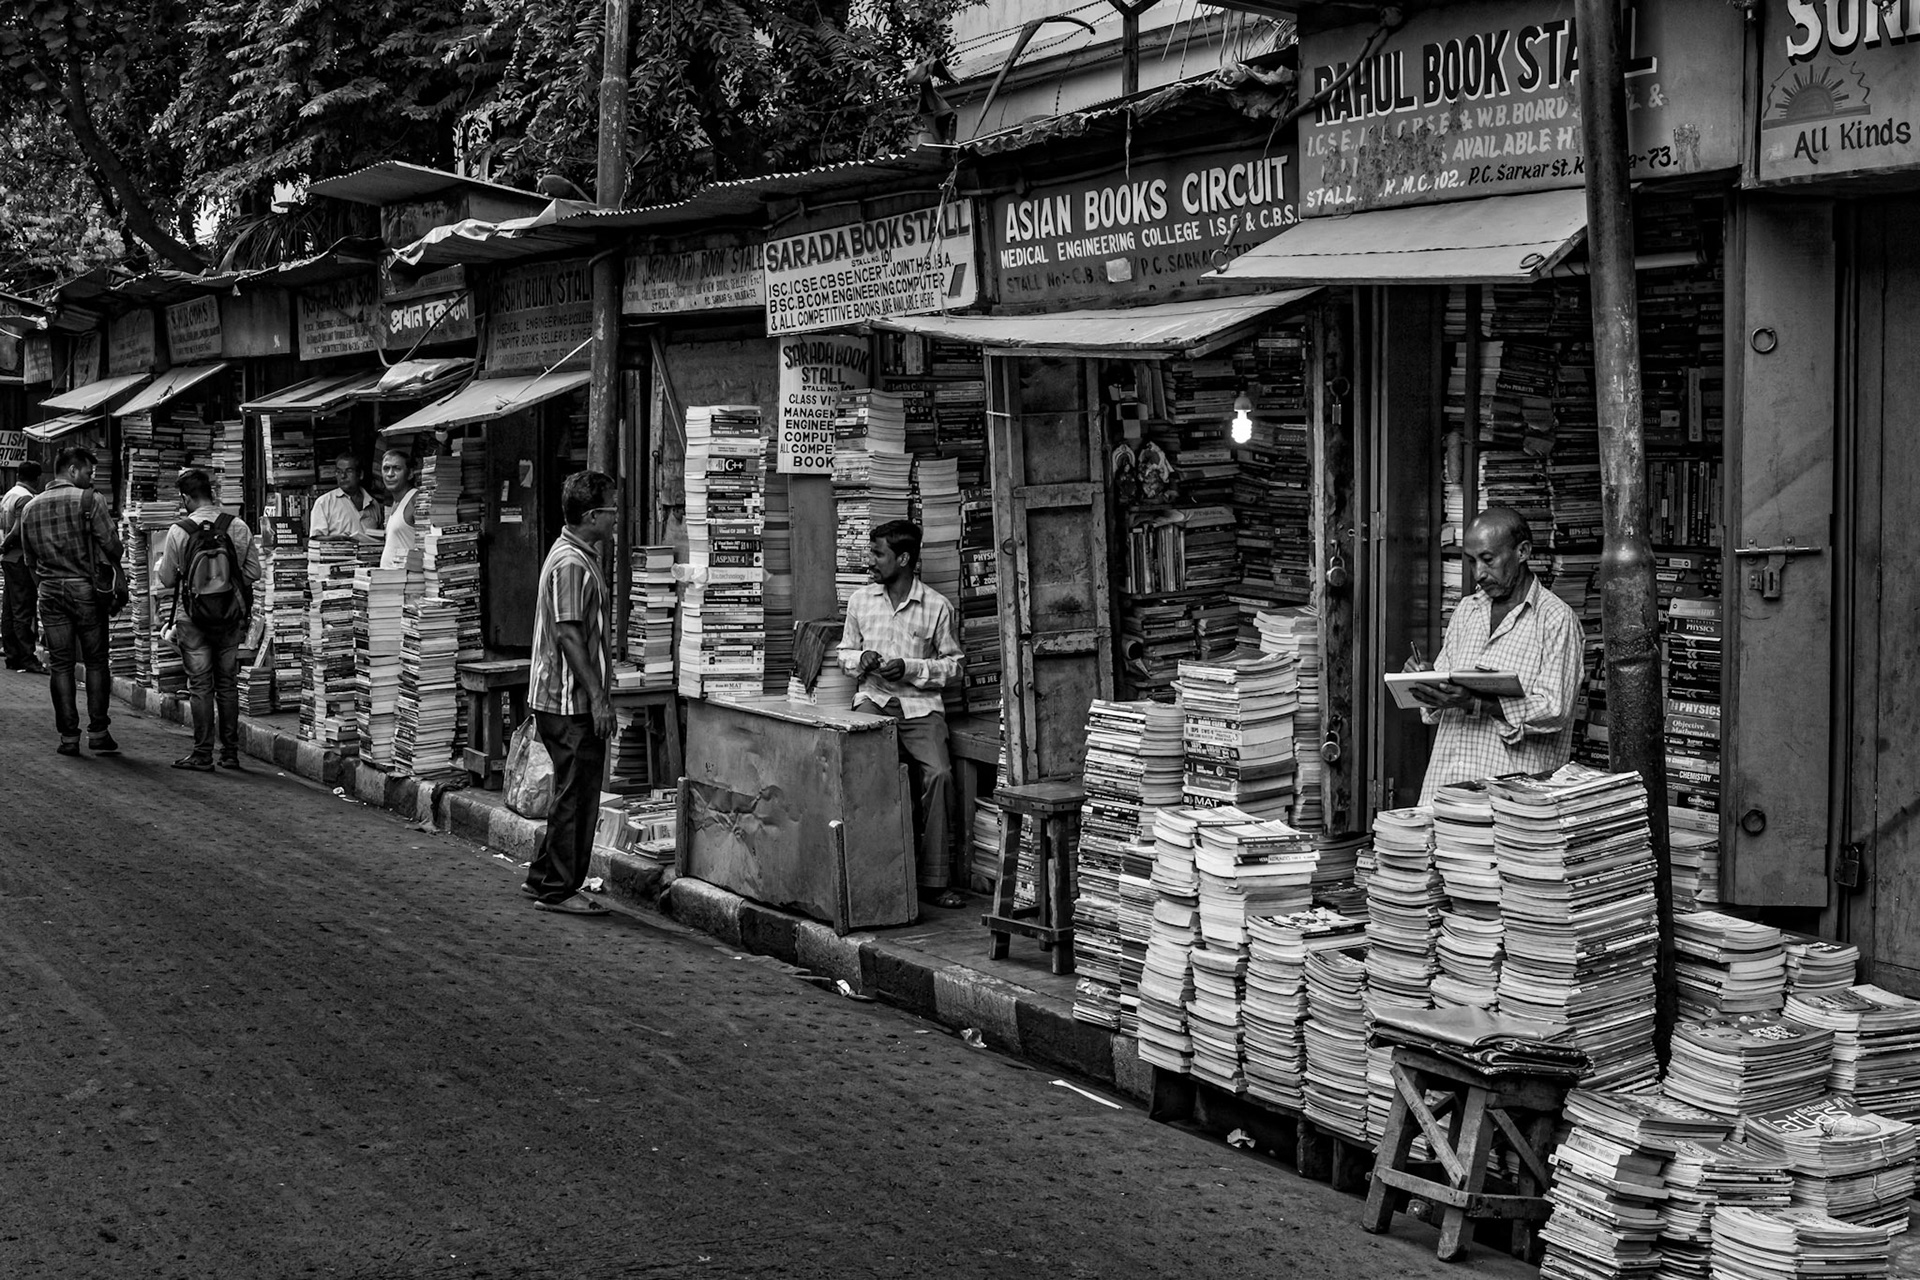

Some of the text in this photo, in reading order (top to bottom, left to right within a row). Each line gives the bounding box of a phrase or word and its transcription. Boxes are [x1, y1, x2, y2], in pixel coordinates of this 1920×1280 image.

[1314, 7, 1657, 127] RAHUL BOOK STAL
[1452, 128, 1552, 162] AVAILABLE
[1794, 118, 1911, 164] All Kinds
[1005, 194, 1072, 244] ASIAN
[1084, 179, 1168, 232] BOOKS
[1181, 155, 1290, 216] CIRCUIT
[765, 201, 972, 273] SARADA BOOK STALL
[1000, 245, 1049, 270] MEDICAL
[1058, 232, 1136, 262] ENGINEERING
[1141, 221, 1202, 248] COLLEGE
[1245, 213, 1256, 231] &
[701, 250, 725, 280] BOOK
[851, 258, 869, 268] STALL
[881, 249, 892, 262] 101
[525, 274, 554, 311] BOOK
[1006, 275, 1043, 294] STALL
[779, 311, 796, 331] ALL
[797, 304, 852, 326] COMPETITIVE
[783, 341, 870, 376] SARADA BOOK
[802, 367, 845, 384] STALL
[789, 394, 817, 405] CLASS
[791, 444, 836, 454] COMPE
[725, 459, 744, 471] C++
[716, 555, 740, 563] ASP.NET
[1686, 624, 1715, 632] PHYSICS
[1679, 702, 1720, 716] PHYSICS
[1671, 727, 1715, 738] Mathematics
[1672, 720, 1705, 730] Objective
[1679, 771, 1712, 782] CHEMISTRY
[1194, 796, 1219, 808] MAT
[1796, 1100, 1834, 1115] School
[1773, 1106, 1852, 1132] atlas
